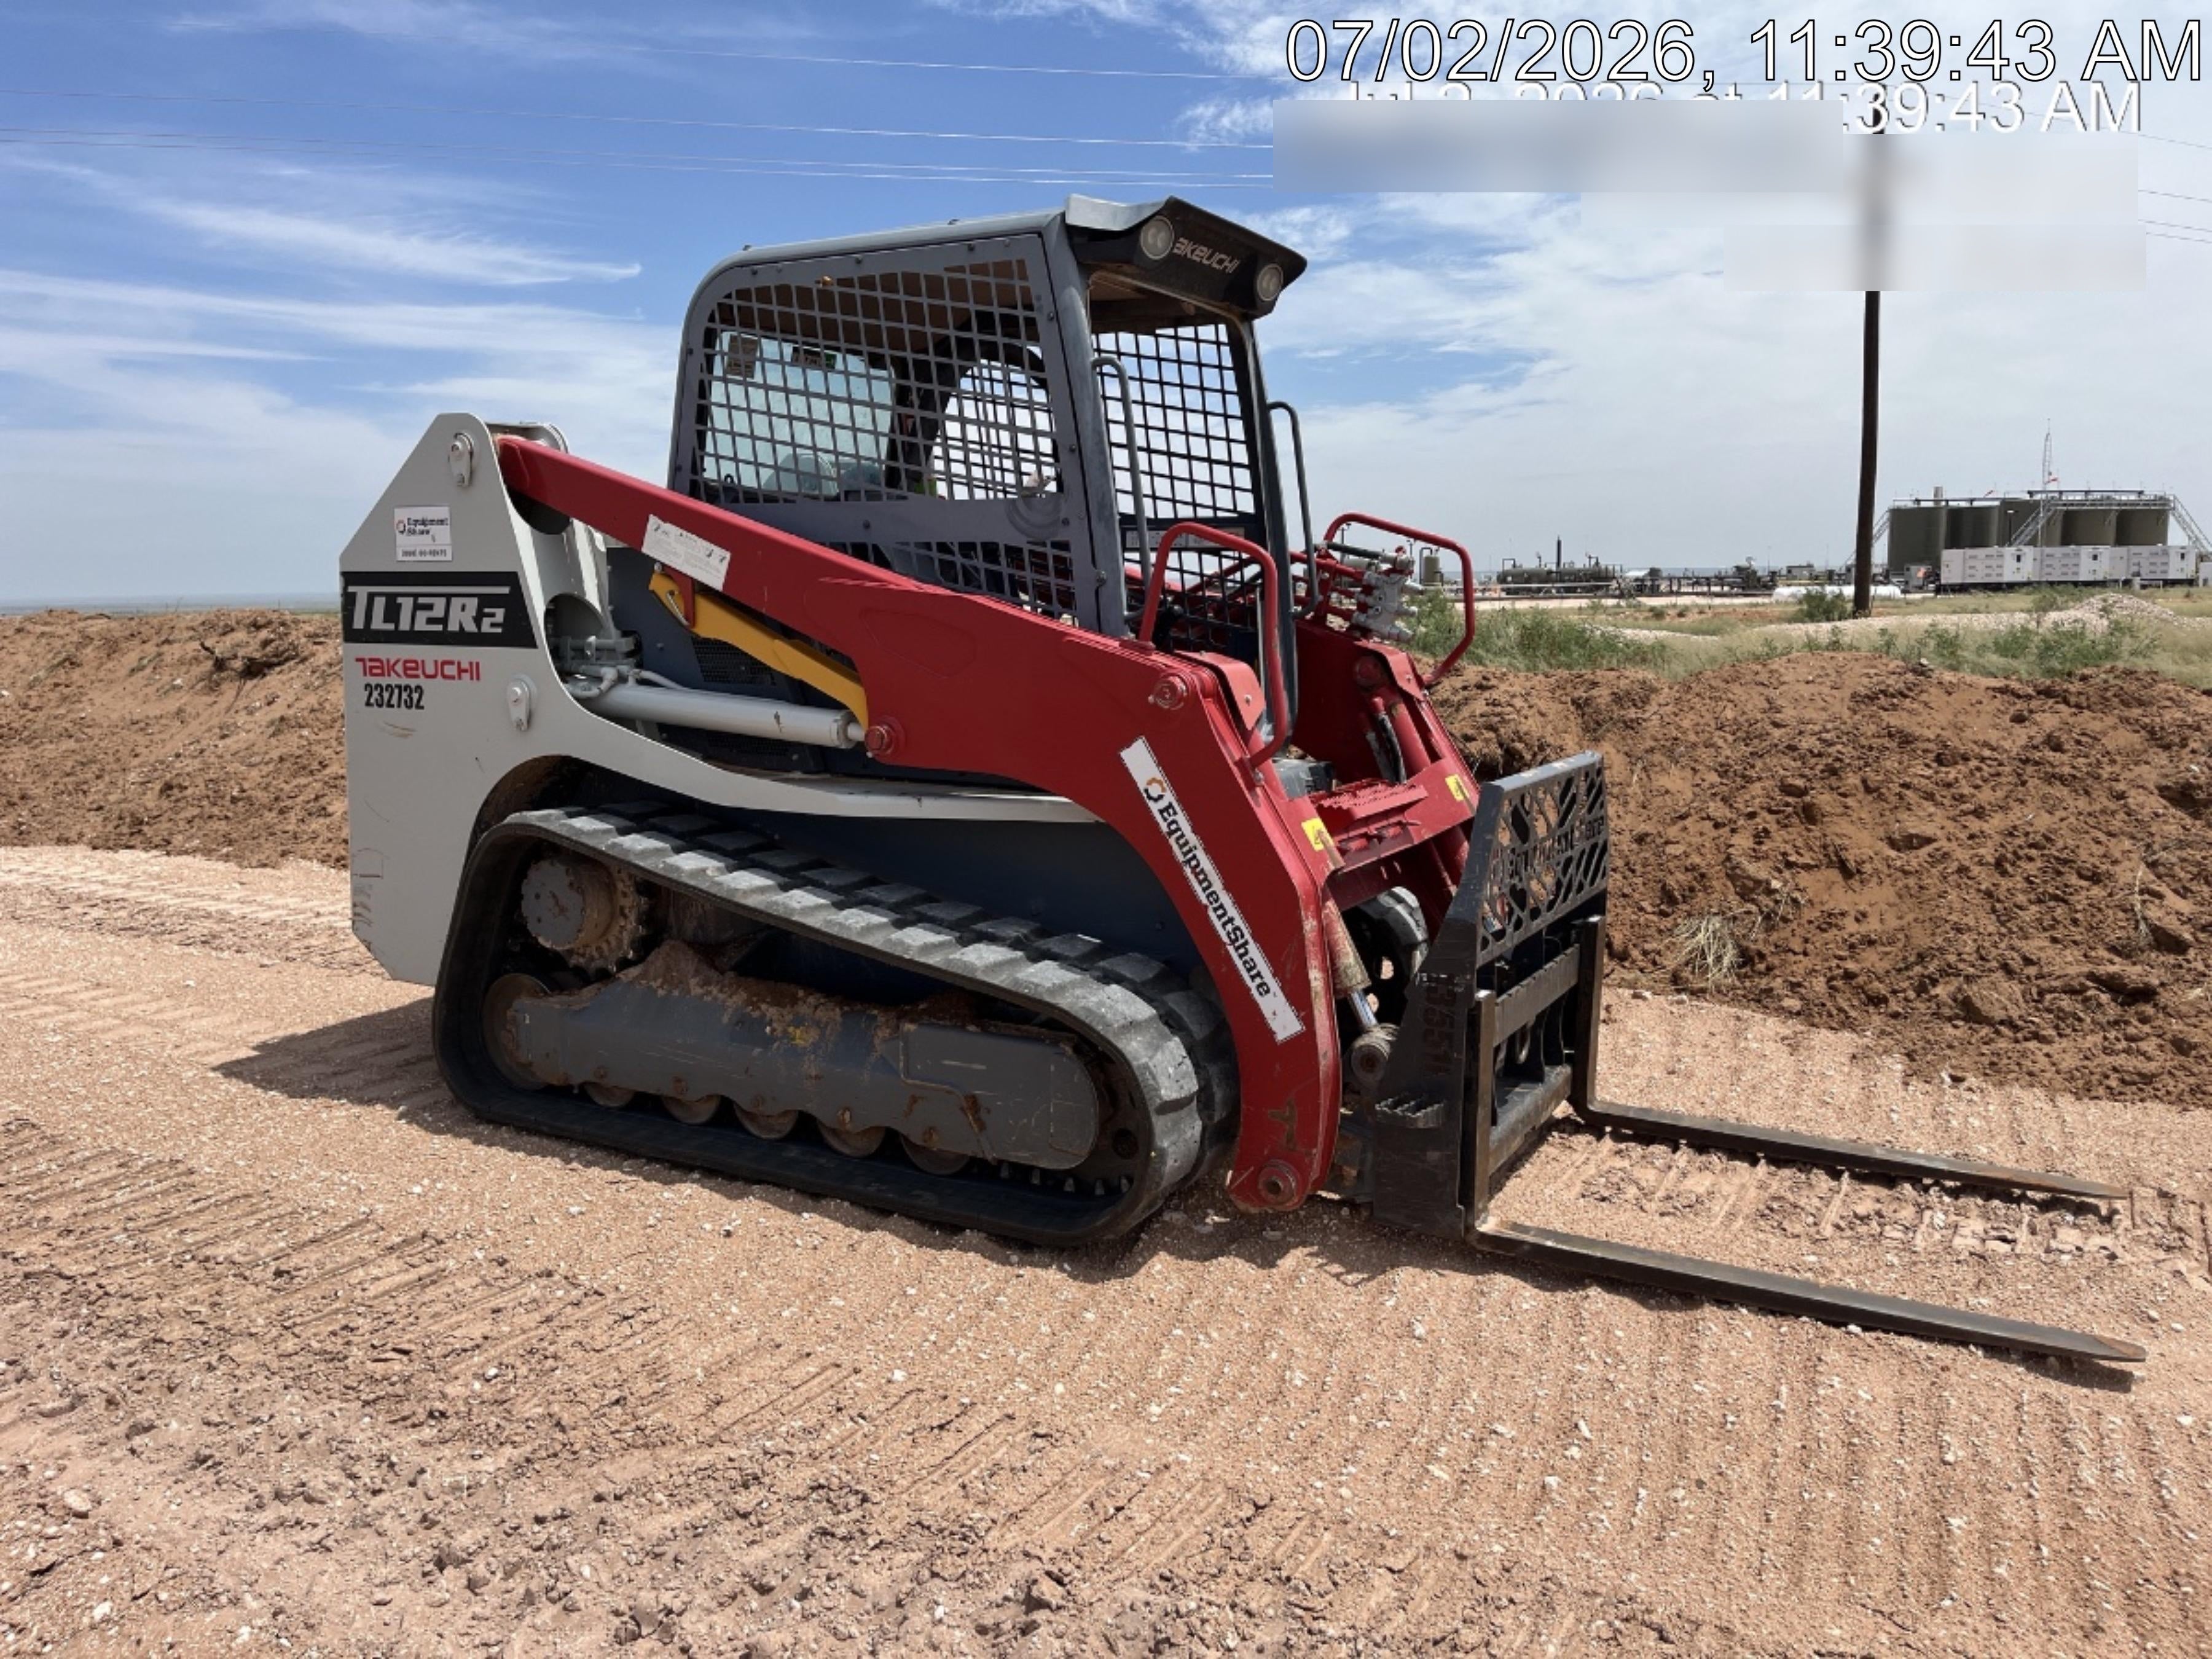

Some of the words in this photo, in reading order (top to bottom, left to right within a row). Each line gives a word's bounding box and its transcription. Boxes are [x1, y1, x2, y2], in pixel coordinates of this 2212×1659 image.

[348, 586, 511, 633] TL12R2
[364, 683, 425, 710] 232732
[1158, 801, 1271, 998] EquipmentShare
